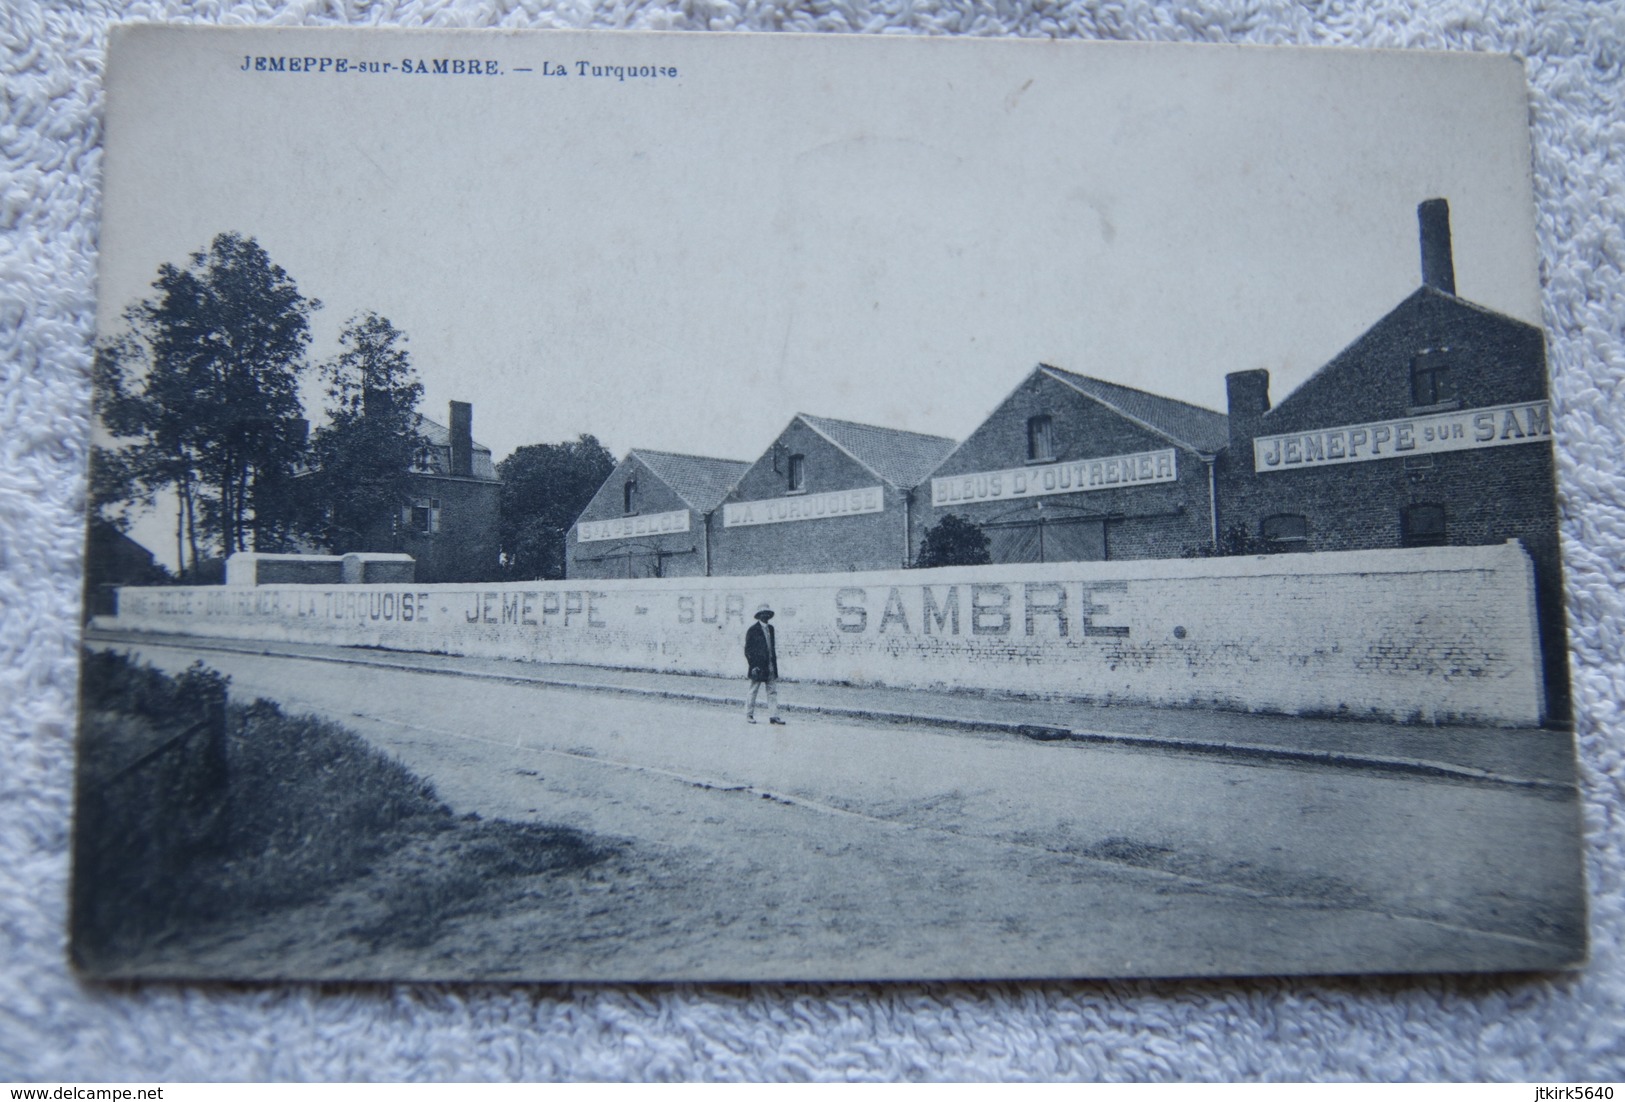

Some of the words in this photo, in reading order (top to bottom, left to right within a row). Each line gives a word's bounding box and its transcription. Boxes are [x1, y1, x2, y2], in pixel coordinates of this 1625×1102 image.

[240, 56, 505, 76] JEMEPPE-sur-SAMBRE.
[543, 60, 568, 76] La
[575, 60, 678, 81] Turquoise
[1264, 423, 1416, 466] JEMEPPE
[1424, 423, 1464, 442] SUR
[936, 471, 1002, 503] BLEUS
[731, 504, 754, 523] LA
[765, 491, 876, 521] TURQUOISE
[324, 592, 429, 624] TURQUOISE
[466, 590, 608, 628] JEMEPPE
[677, 593, 745, 625] SUR
[835, 581, 1130, 638] SAMBRE
